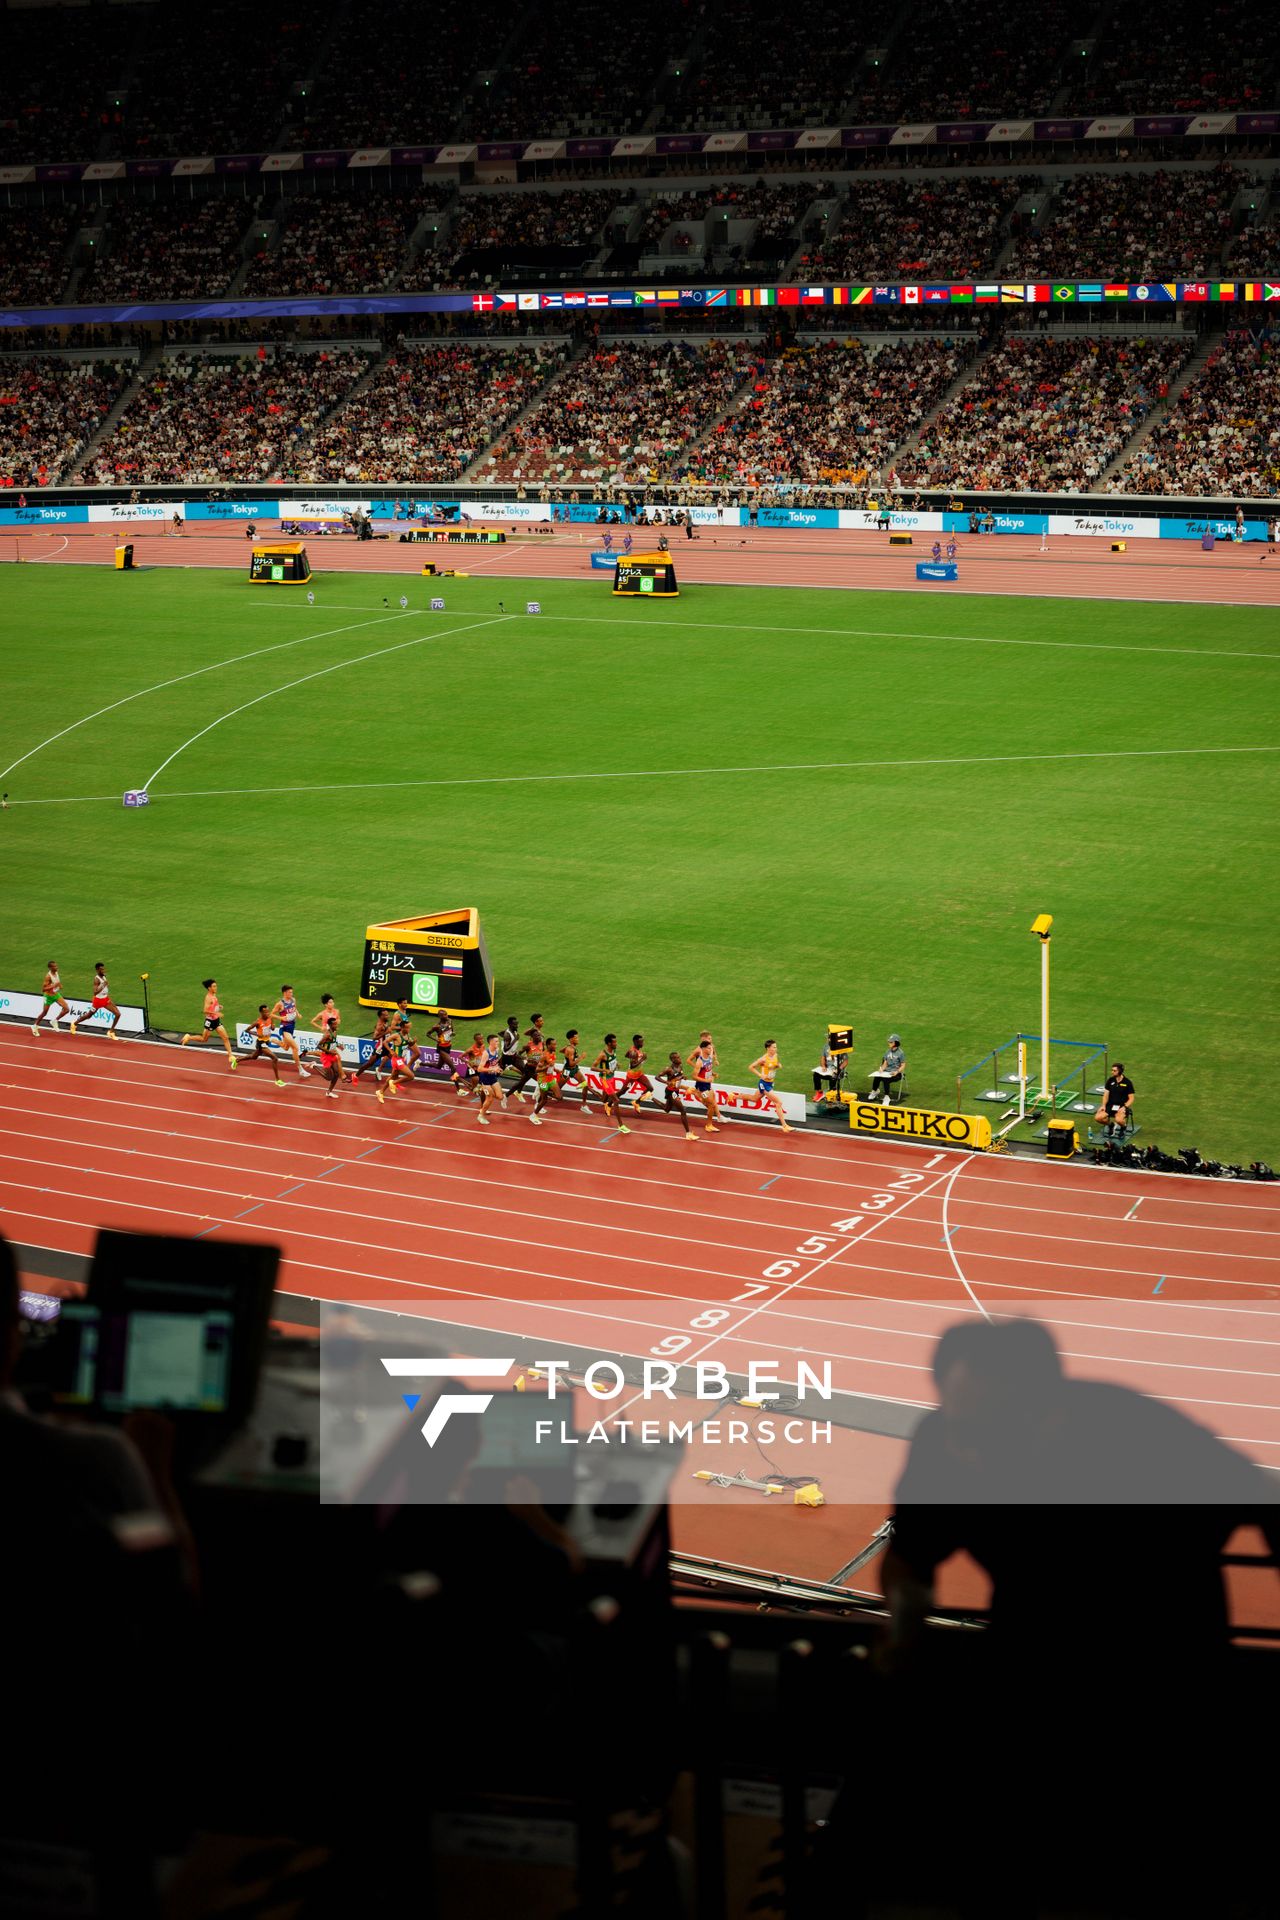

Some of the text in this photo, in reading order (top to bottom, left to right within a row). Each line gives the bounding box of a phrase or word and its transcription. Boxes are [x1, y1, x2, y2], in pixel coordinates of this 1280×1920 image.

[433, 601, 444, 609] 70
[528, 604, 540, 613] 65
[138, 793, 148, 805] 65
[427, 936, 463, 947] SEIKO
[371, 953, 415, 969] リナレス
[369, 969, 385, 980] A:5
[857, 1105, 970, 1140] SEIKO
[923, 1153, 947, 1168] 1
[887, 1173, 925, 1190] 2
[860, 1193, 896, 1210] 3
[830, 1215, 865, 1233] 4
[796, 1235, 837, 1254] 5
[762, 1259, 801, 1278] 6
[729, 1282, 770, 1302] 7
[689, 1309, 730, 1328] 8
[649, 1335, 692, 1356] 9
